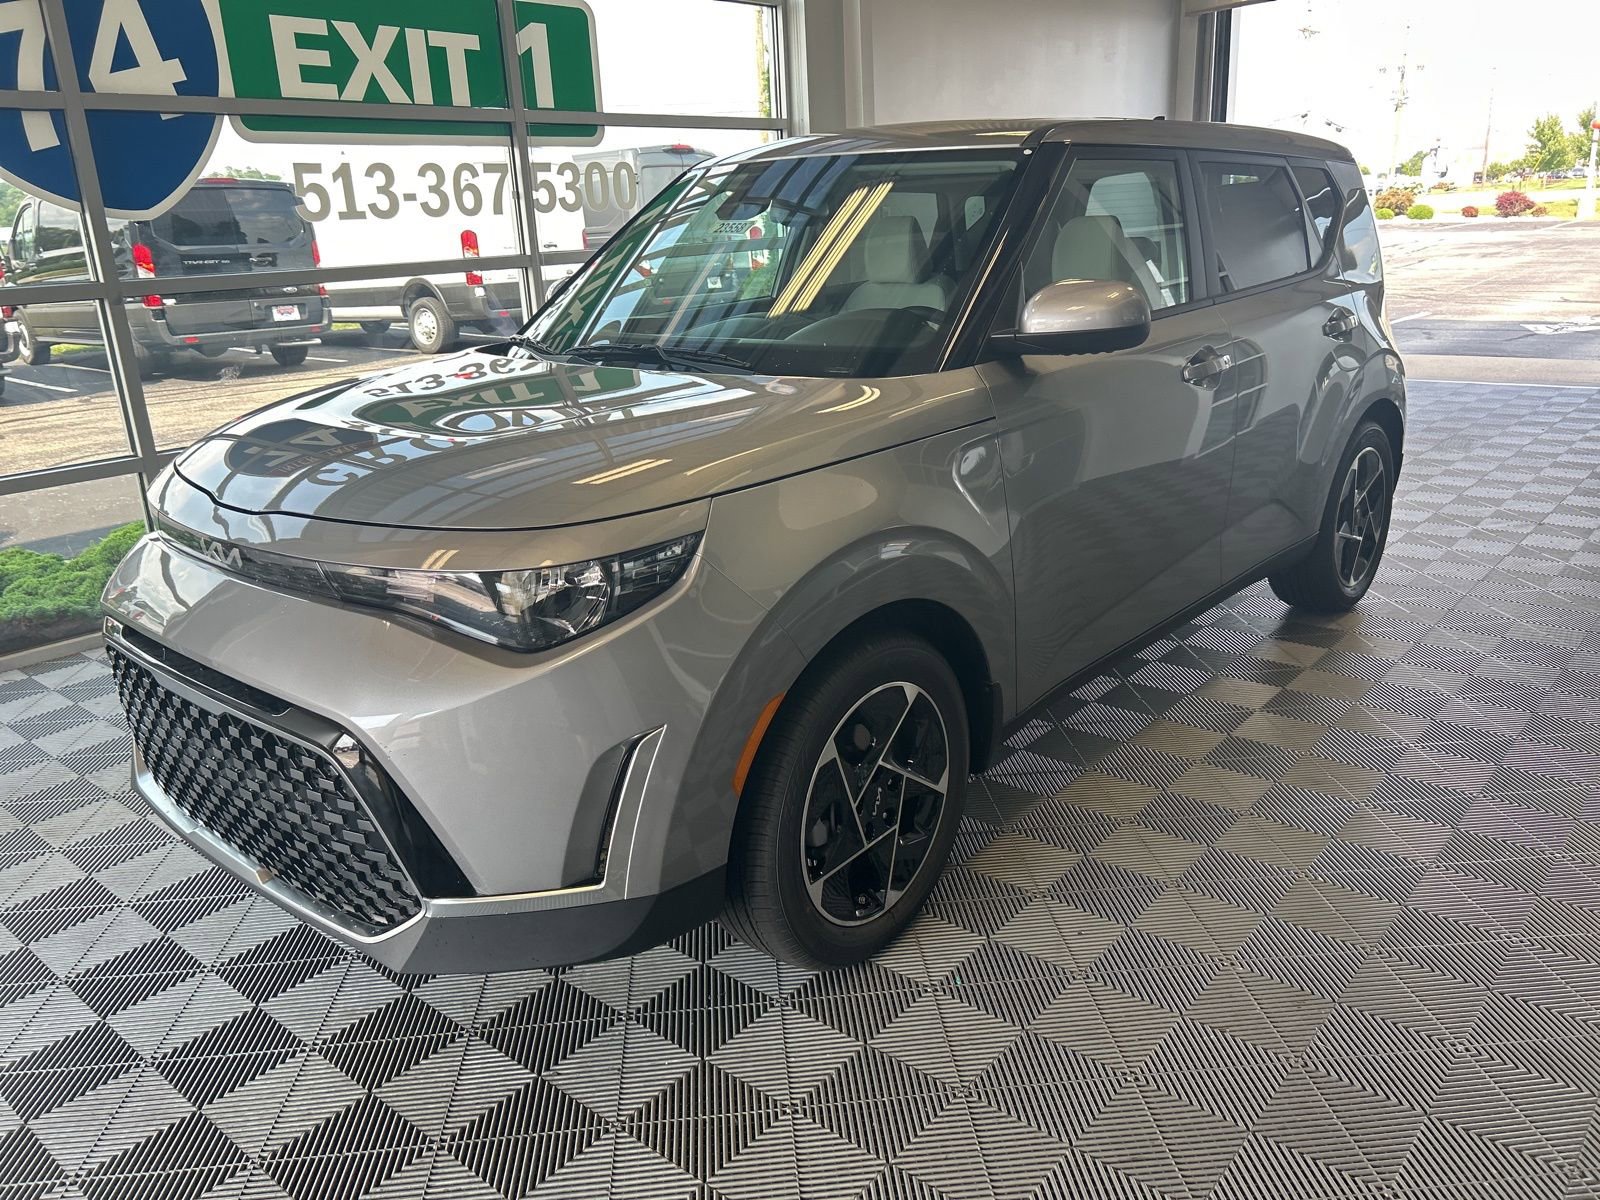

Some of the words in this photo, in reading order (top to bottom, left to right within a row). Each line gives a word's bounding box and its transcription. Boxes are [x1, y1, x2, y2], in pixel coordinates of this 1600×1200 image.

[0, 0, 187, 151] 74
[268, 14, 481, 108] EXIT
[515, 22, 555, 109] 1
[292, 161, 637, 222] 513-3675300
[200, 536, 243, 569] KIA
